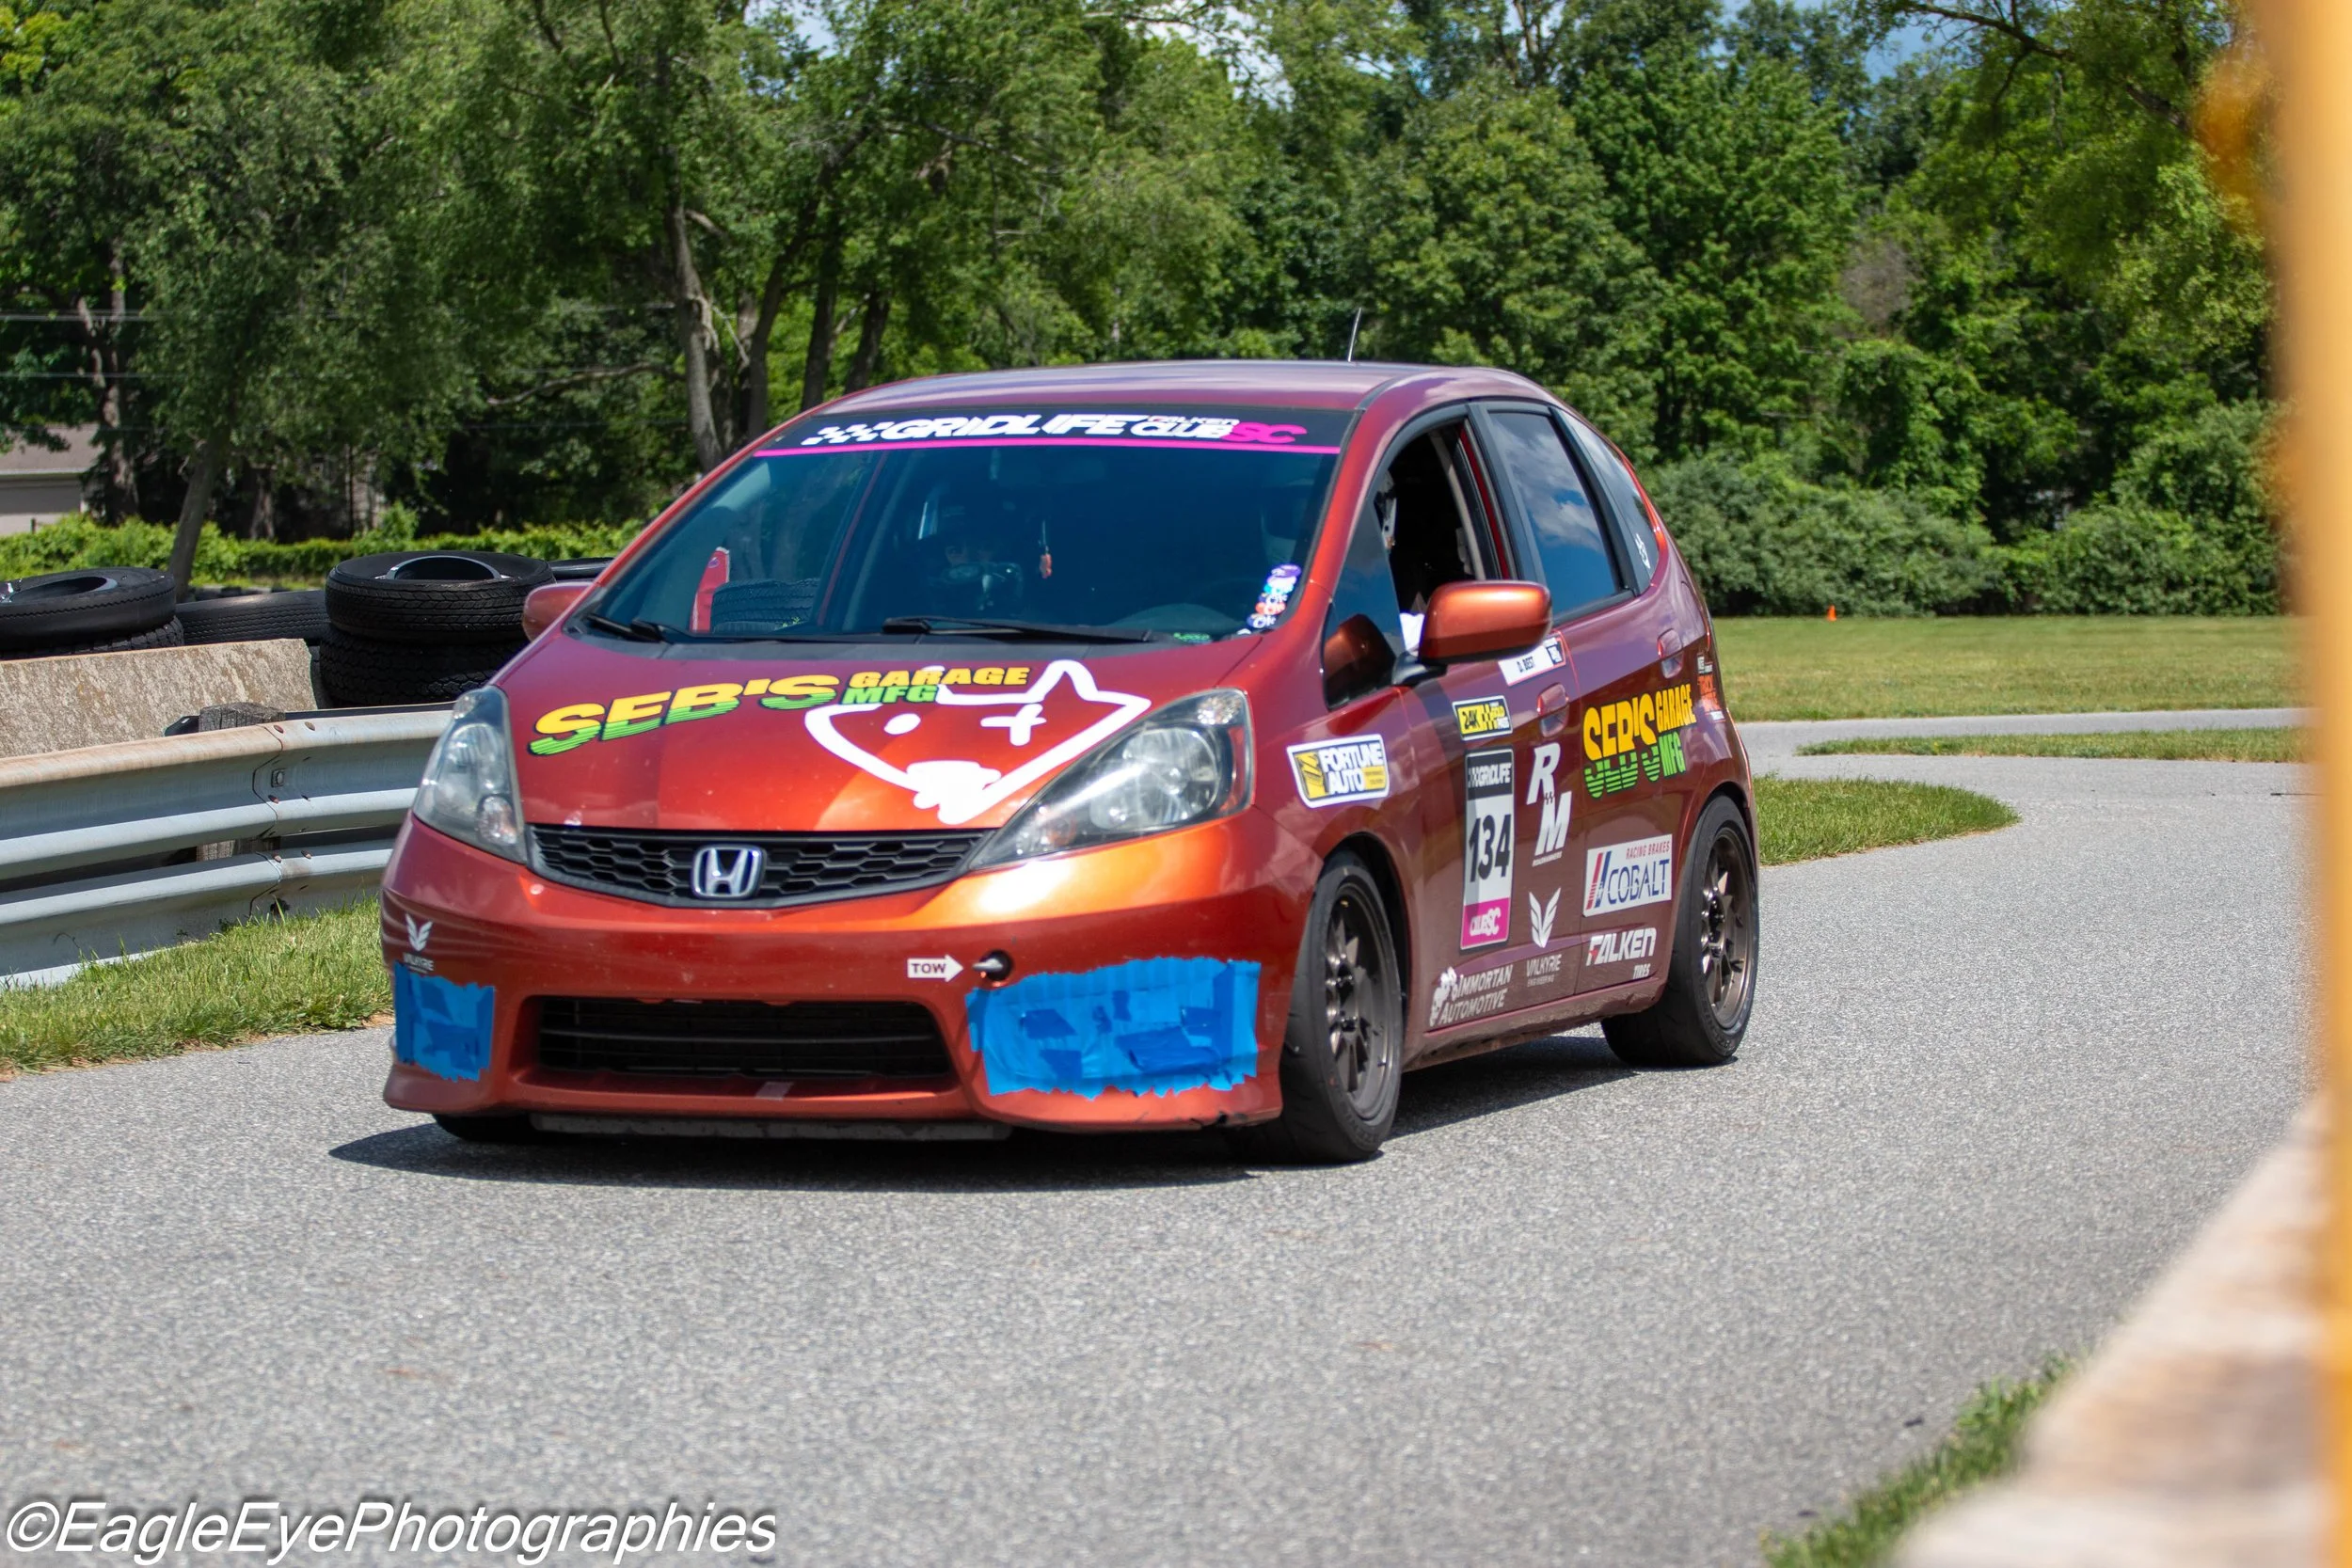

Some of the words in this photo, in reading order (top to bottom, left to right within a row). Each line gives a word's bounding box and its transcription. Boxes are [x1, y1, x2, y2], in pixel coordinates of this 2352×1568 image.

[881, 414, 1149, 440] GRIDLIFE
[530, 674, 840, 755] SEB'S
[849, 667, 1030, 689] GARAGE
[840, 685, 938, 705] MFG
[1318, 743, 1383, 772] FORTUNE
[1583, 693, 1660, 798] SEB'S
[1655, 684, 1696, 733] GARAGE
[1659, 731, 1686, 777] MFG
[1328, 769, 1365, 795] AUTO
[1473, 763, 1512, 786] GRIDLIFE
[1526, 743, 1561, 805] R
[1534, 790, 1572, 856] M
[1469, 815, 1511, 882] 134
[1626, 845, 1647, 860] RACING
[1647, 841, 1671, 856] BRAKES
[1608, 858, 1670, 905] COBALT
[1586, 927, 1657, 967] FALKEN
[911, 962, 946, 974] TOW
[1458, 965, 1513, 998] IMMORTAN
[1526, 954, 1562, 977] VALKYRIE
[1632, 963, 1651, 979] TIRES
[1438, 989, 1507, 1025] AUTOMOTIVE
